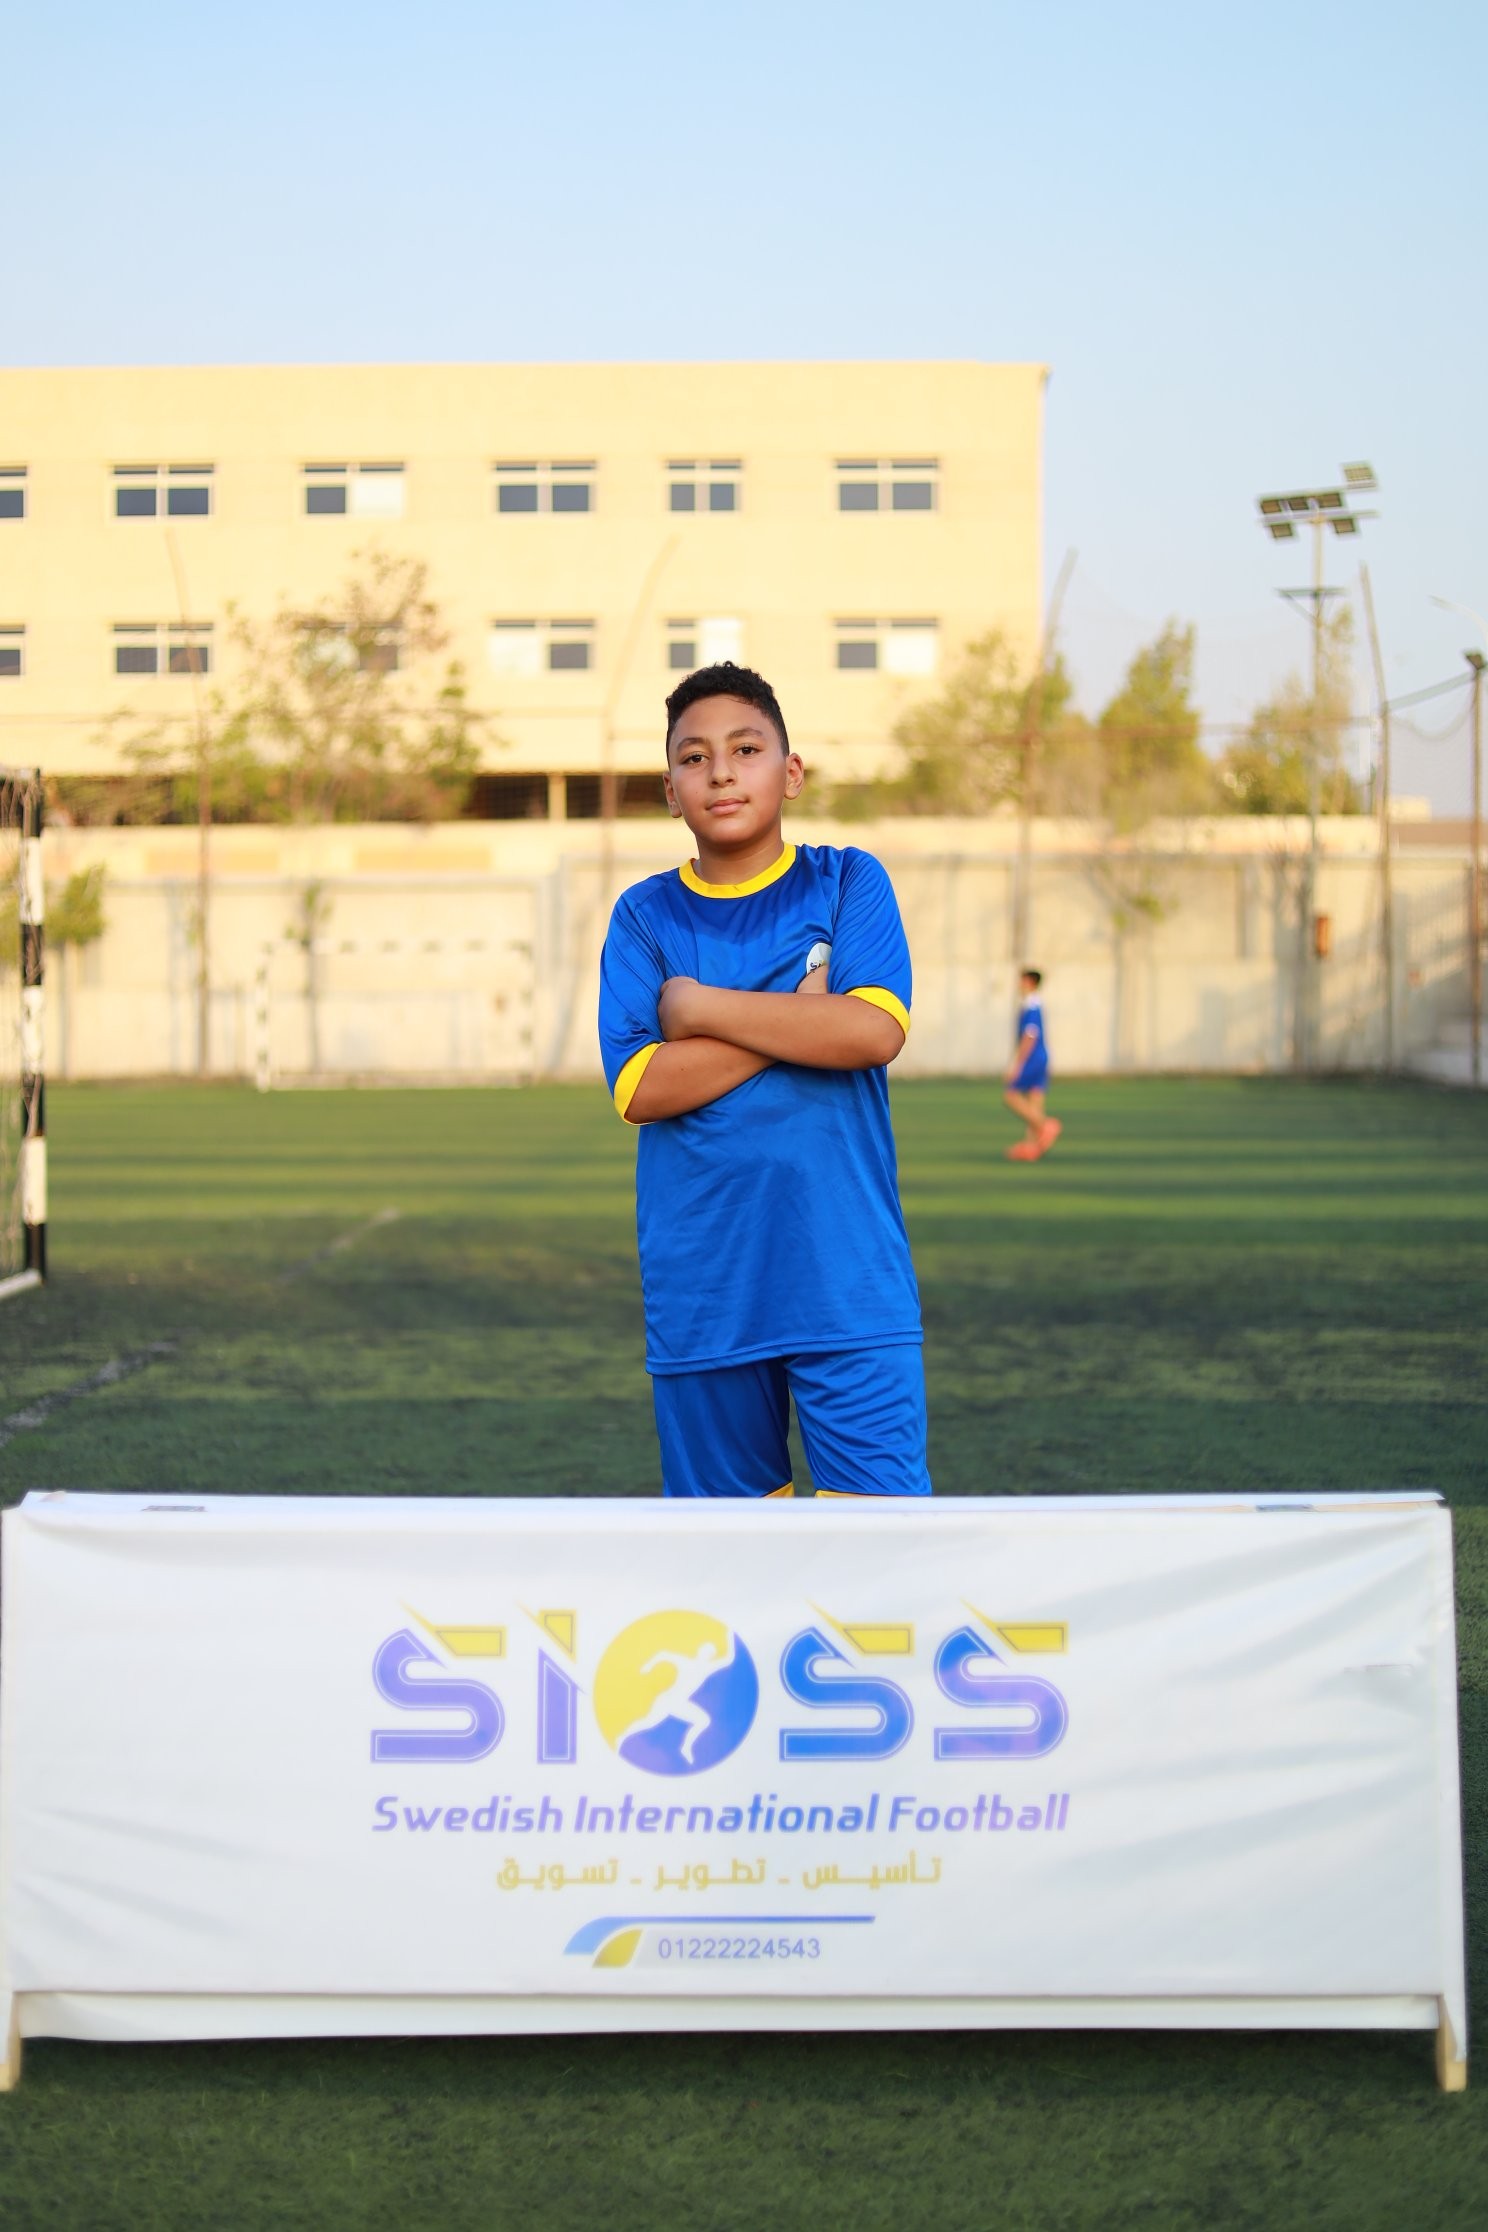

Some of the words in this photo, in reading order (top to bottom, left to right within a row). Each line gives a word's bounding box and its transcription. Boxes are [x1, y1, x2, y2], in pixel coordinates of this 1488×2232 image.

[372, 1794, 564, 1833] Swedish
[574, 1792, 881, 1833] International
[887, 1792, 1070, 1832] Football
[657, 1937, 821, 1960] 01222224543
